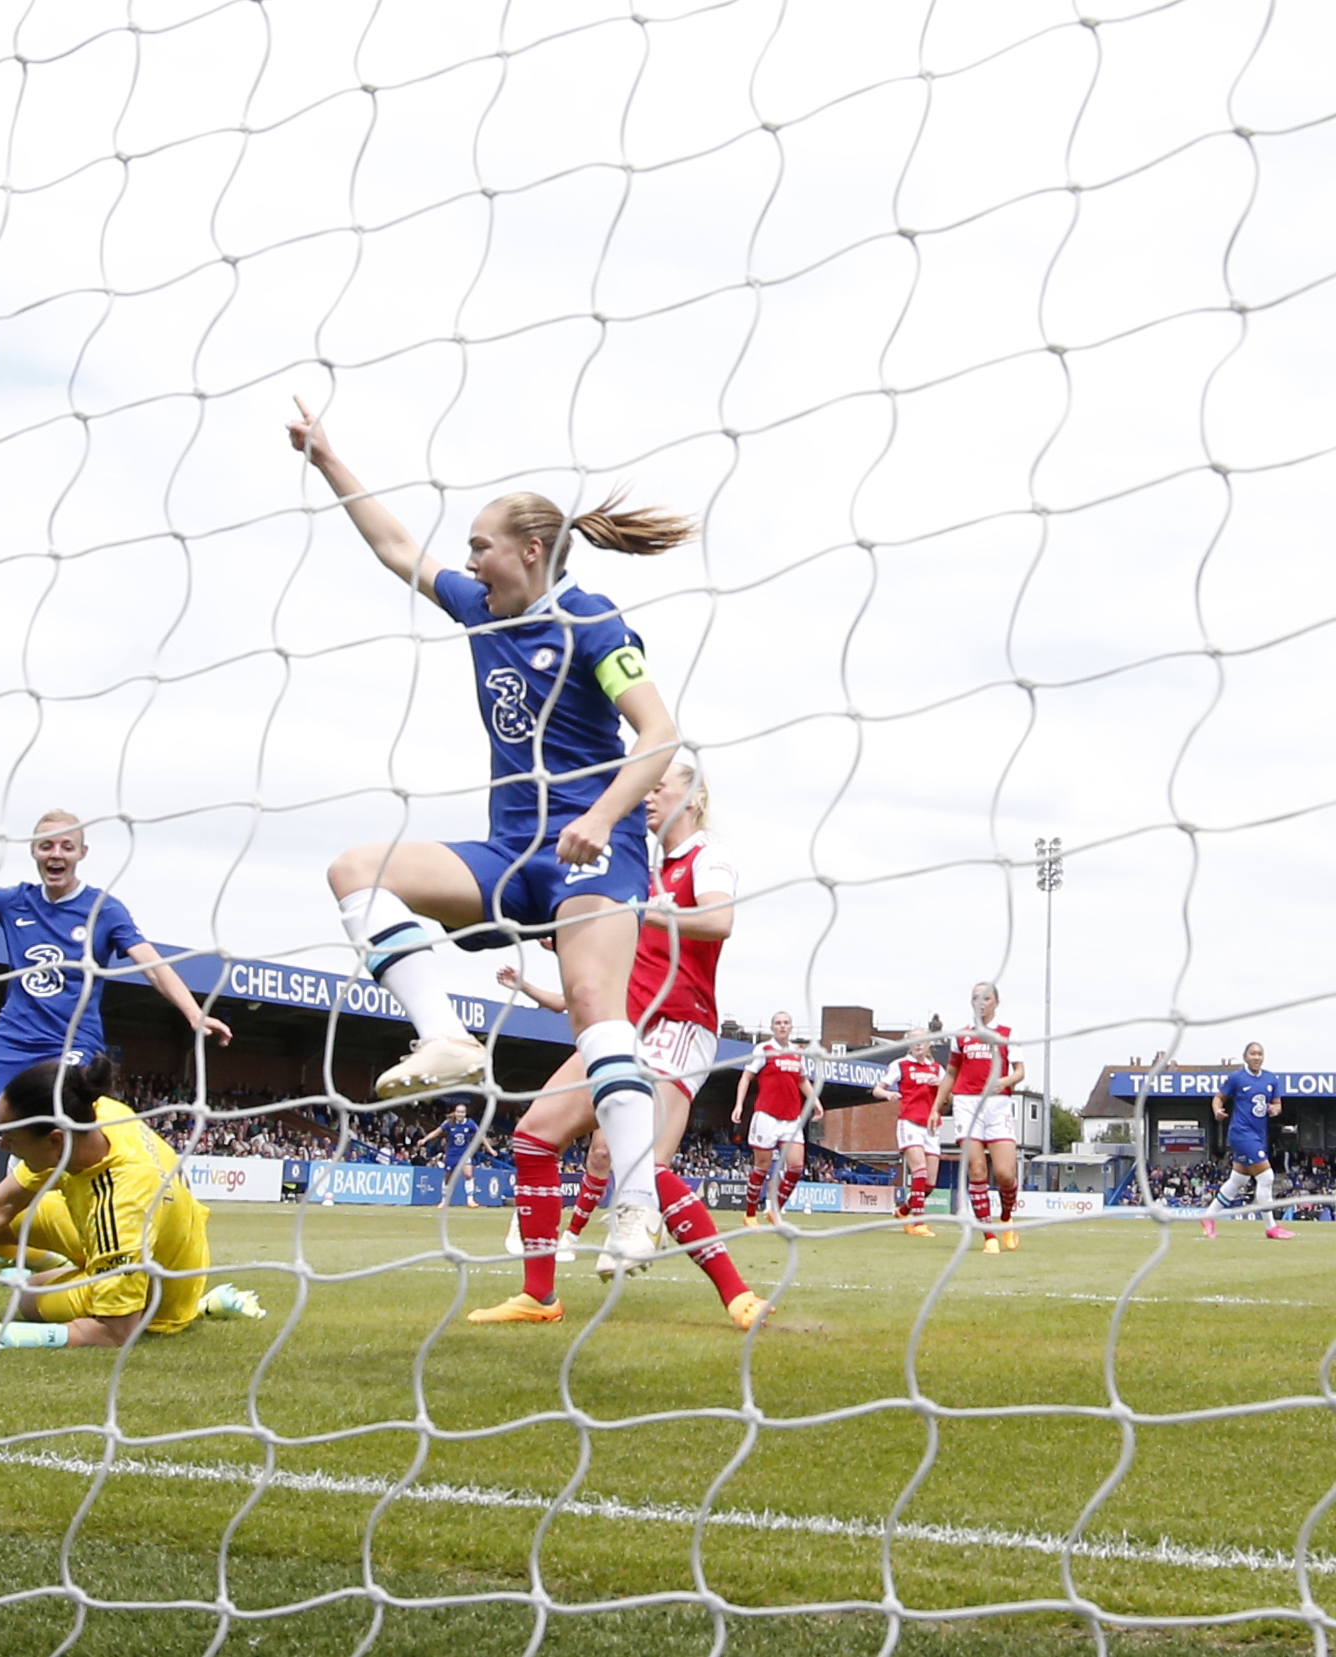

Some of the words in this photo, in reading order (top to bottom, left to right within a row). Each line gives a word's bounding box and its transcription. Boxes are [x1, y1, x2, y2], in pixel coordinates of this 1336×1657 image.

[616, 652, 643, 680] C
[230, 963, 331, 1007] CHELSEA
[336, 980, 407, 1018] FOOTB
[452, 999, 485, 1029] LUB
[1130, 1075, 1174, 1093] THE
[190, 1164, 246, 1192] trivago
[333, 1168, 412, 1197] BARCLAYS
[797, 1187, 837, 1205] BARCLAYS
[858, 1191, 878, 1207] Three
[1046, 1197, 1093, 1215] trivago
